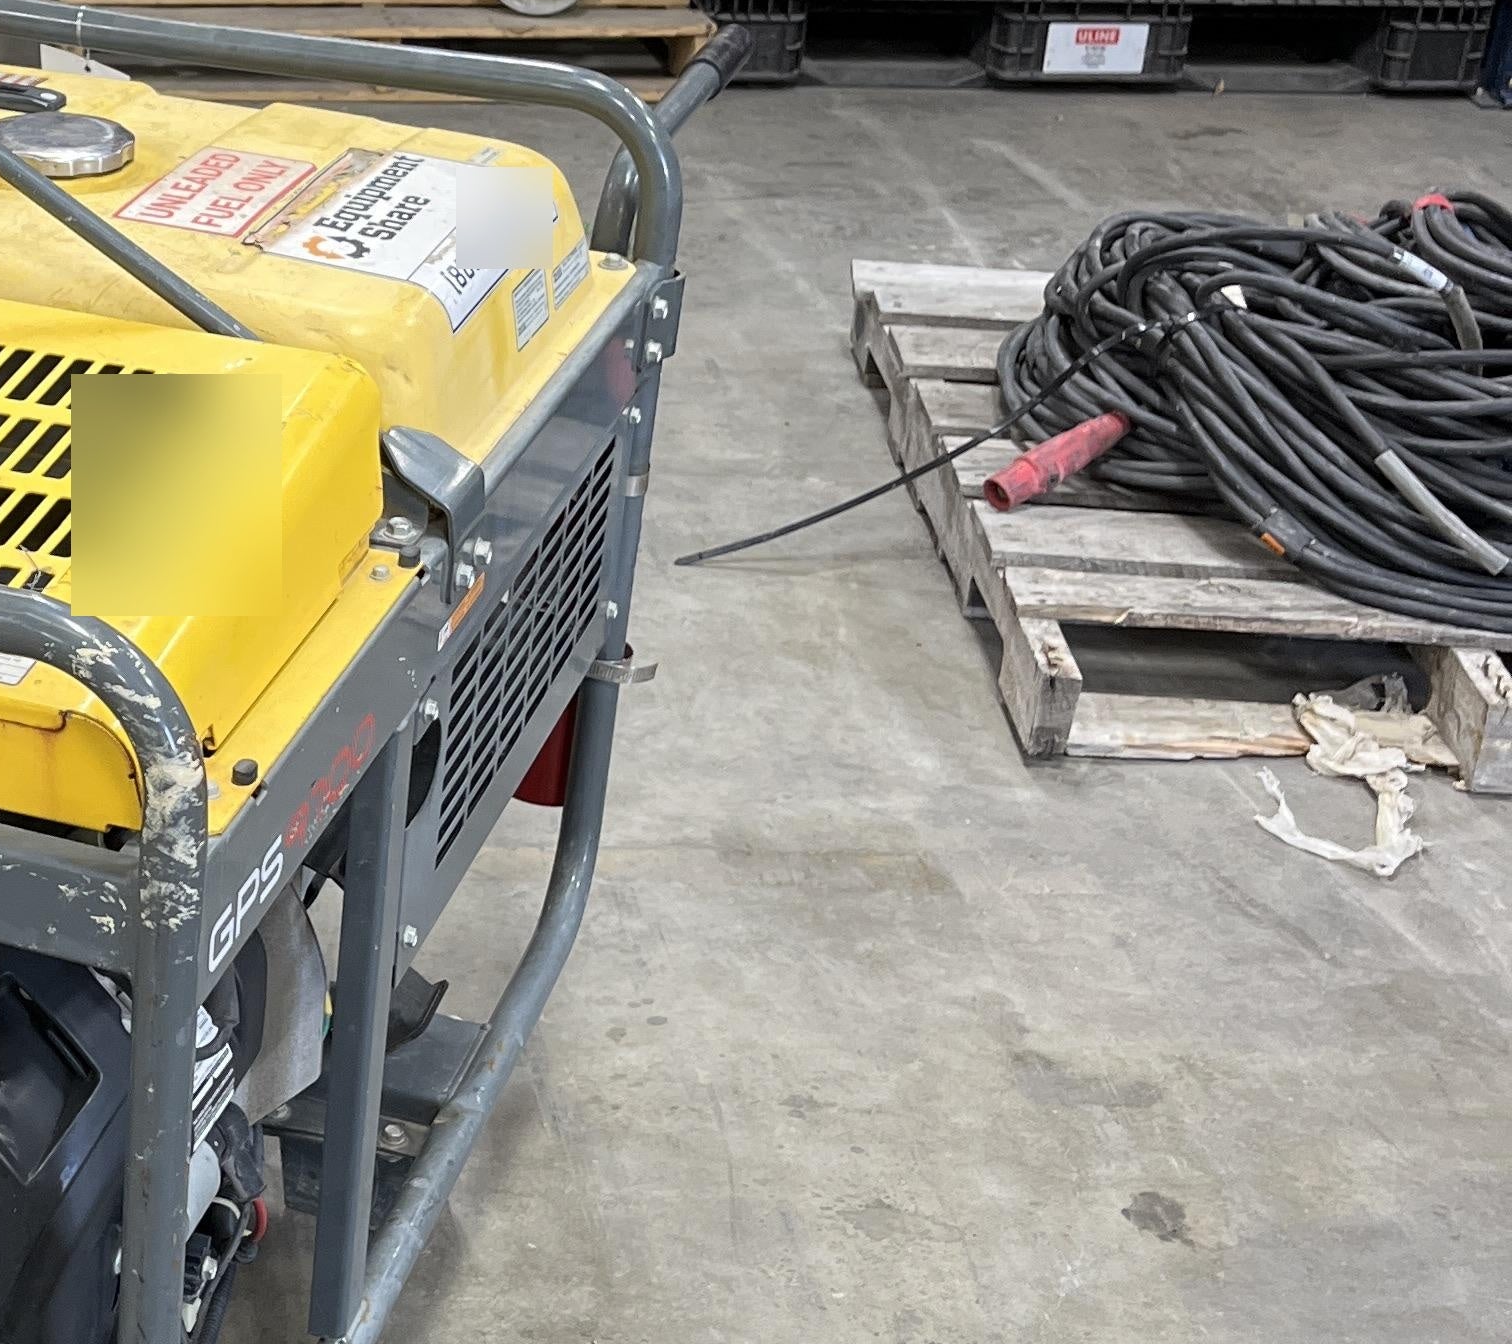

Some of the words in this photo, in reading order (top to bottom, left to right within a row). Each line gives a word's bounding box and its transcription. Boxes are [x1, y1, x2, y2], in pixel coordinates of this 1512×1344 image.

[139, 152, 241, 220] UNLEADED
[191, 193, 252, 229] FUEL
[232, 160, 291, 194] ONLY
[313, 151, 425, 233] Equipment
[357, 194, 432, 242] Share
